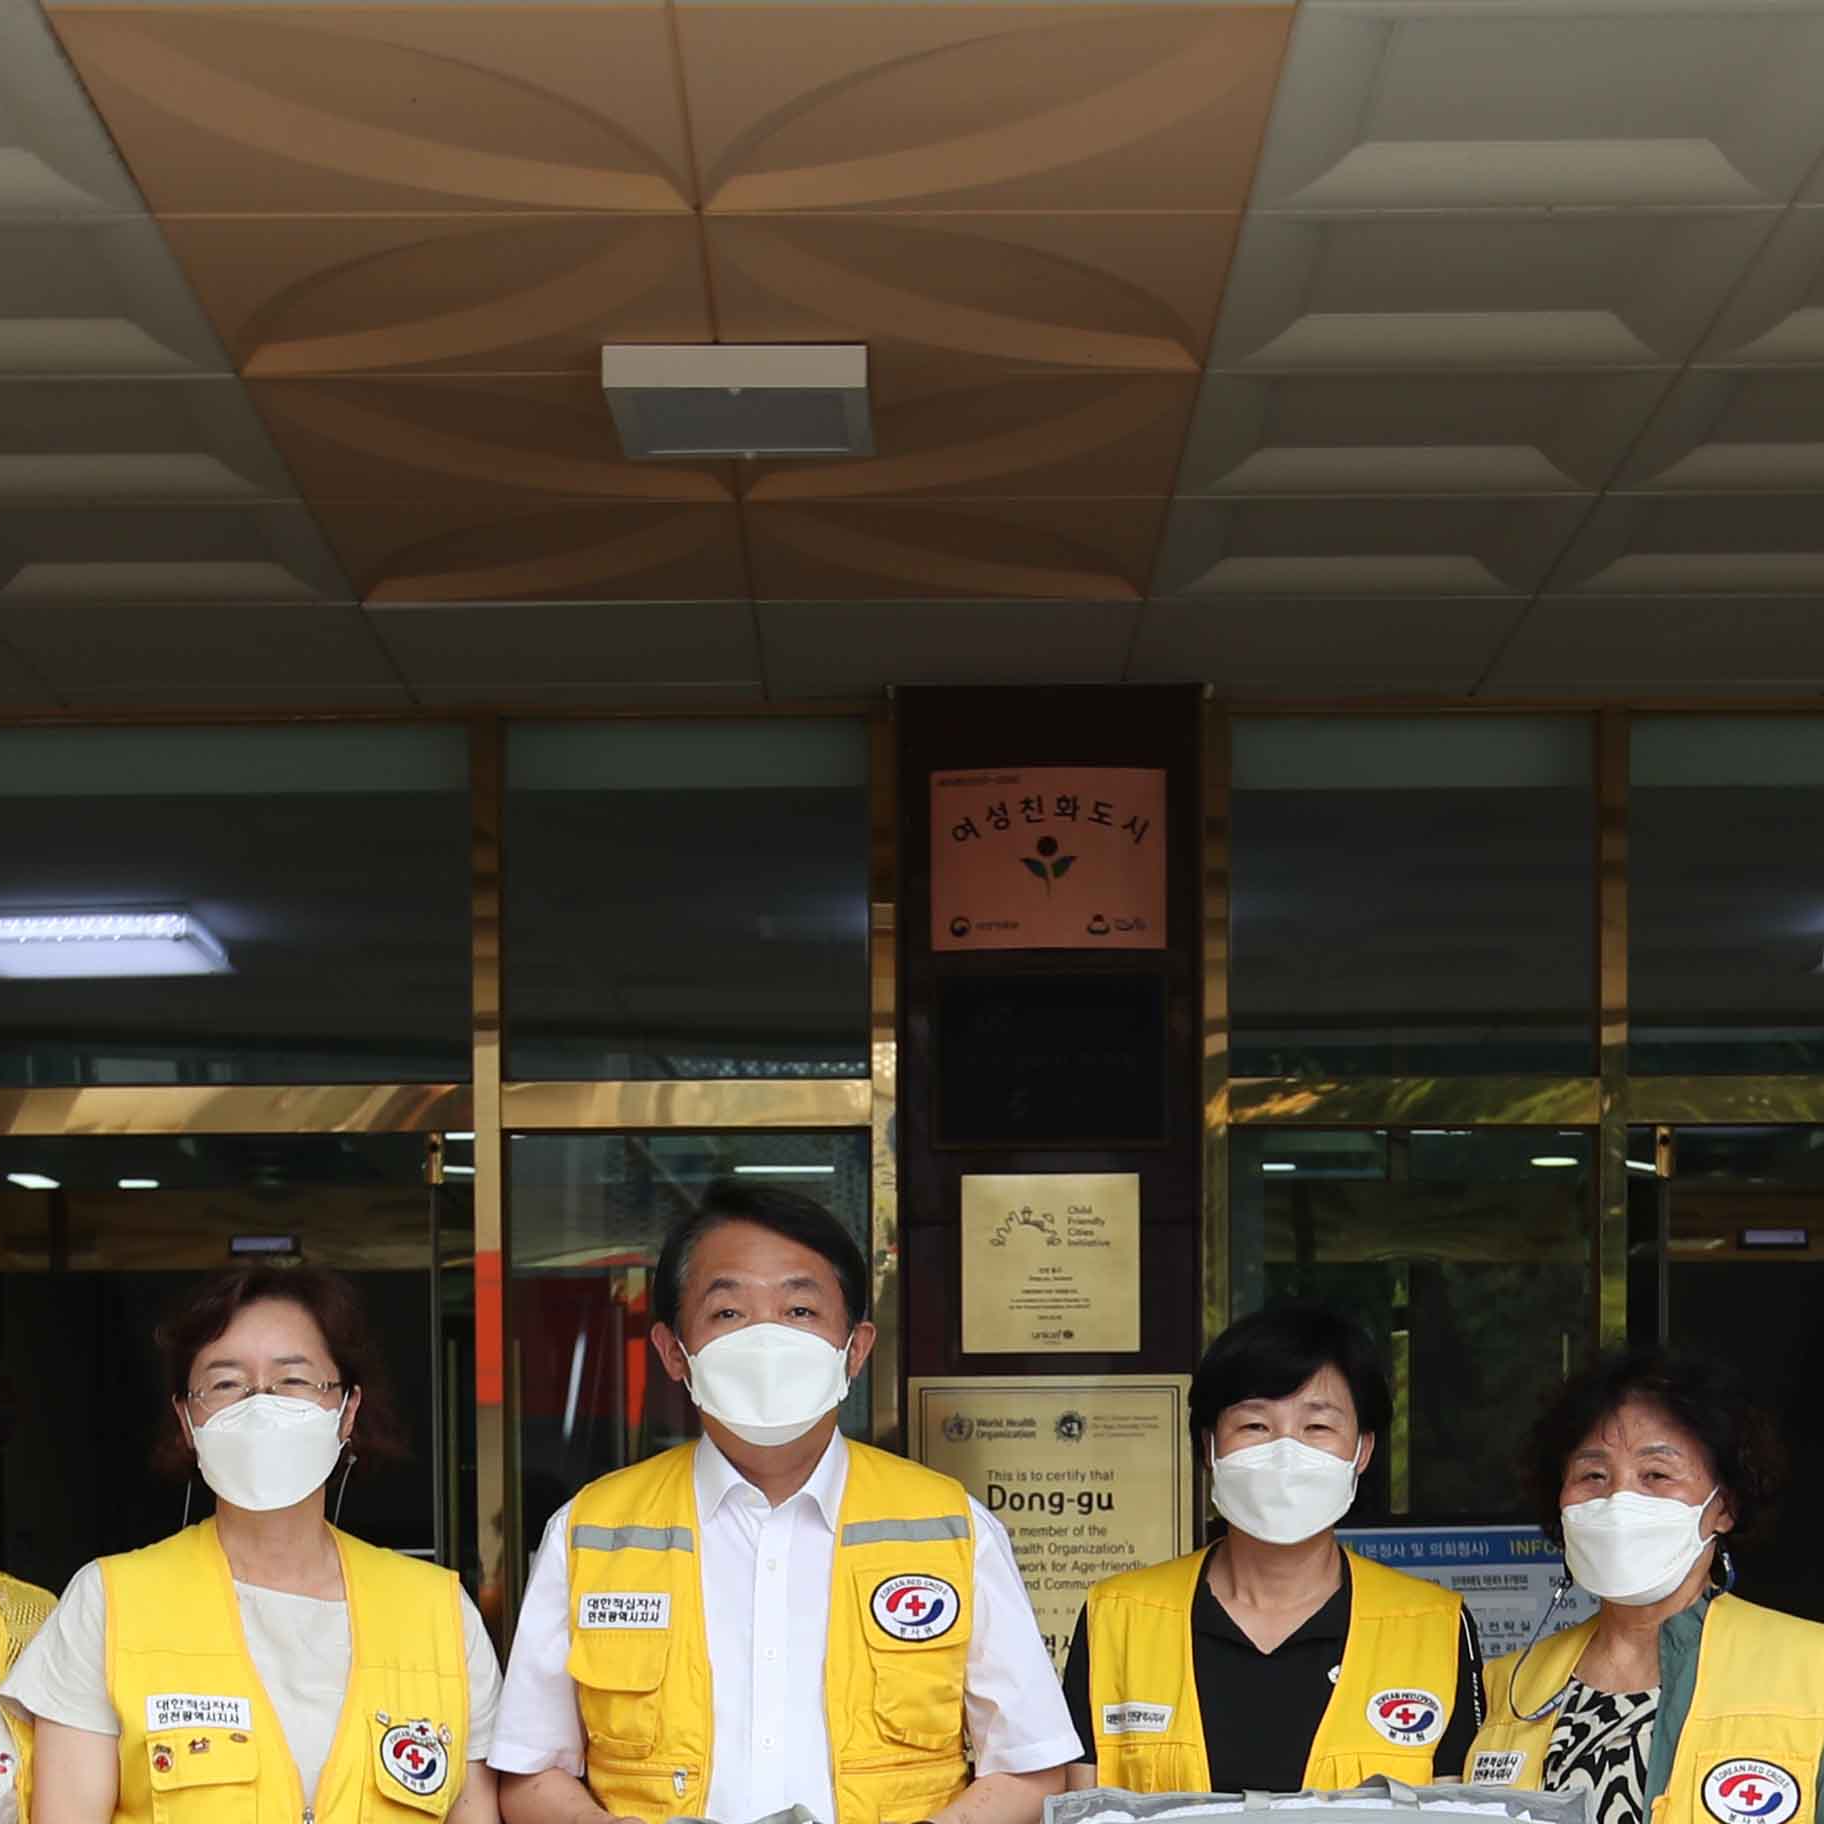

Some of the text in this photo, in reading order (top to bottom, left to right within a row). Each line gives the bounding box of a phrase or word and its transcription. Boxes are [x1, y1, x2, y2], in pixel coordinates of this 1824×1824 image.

[951, 795, 1151, 844] 여성친화도시
[1068, 1205, 1092, 1214] Child
[1068, 1217, 1105, 1226] Friendly
[1068, 1228, 1094, 1236] Cities
[1032, 1330, 1062, 1339] unicef
[988, 1470, 1114, 1484] This is to certify that
[986, 1484, 1114, 1515] Dong-gu
[1020, 1525, 1107, 1537] member of the
[1012, 1541, 1135, 1554] ealth Organization's
[1052, 1561, 1068, 1572] for
[587, 1598, 661, 1610] 대한적십자사
[155, 1699, 238, 1713] 대한적십자사
